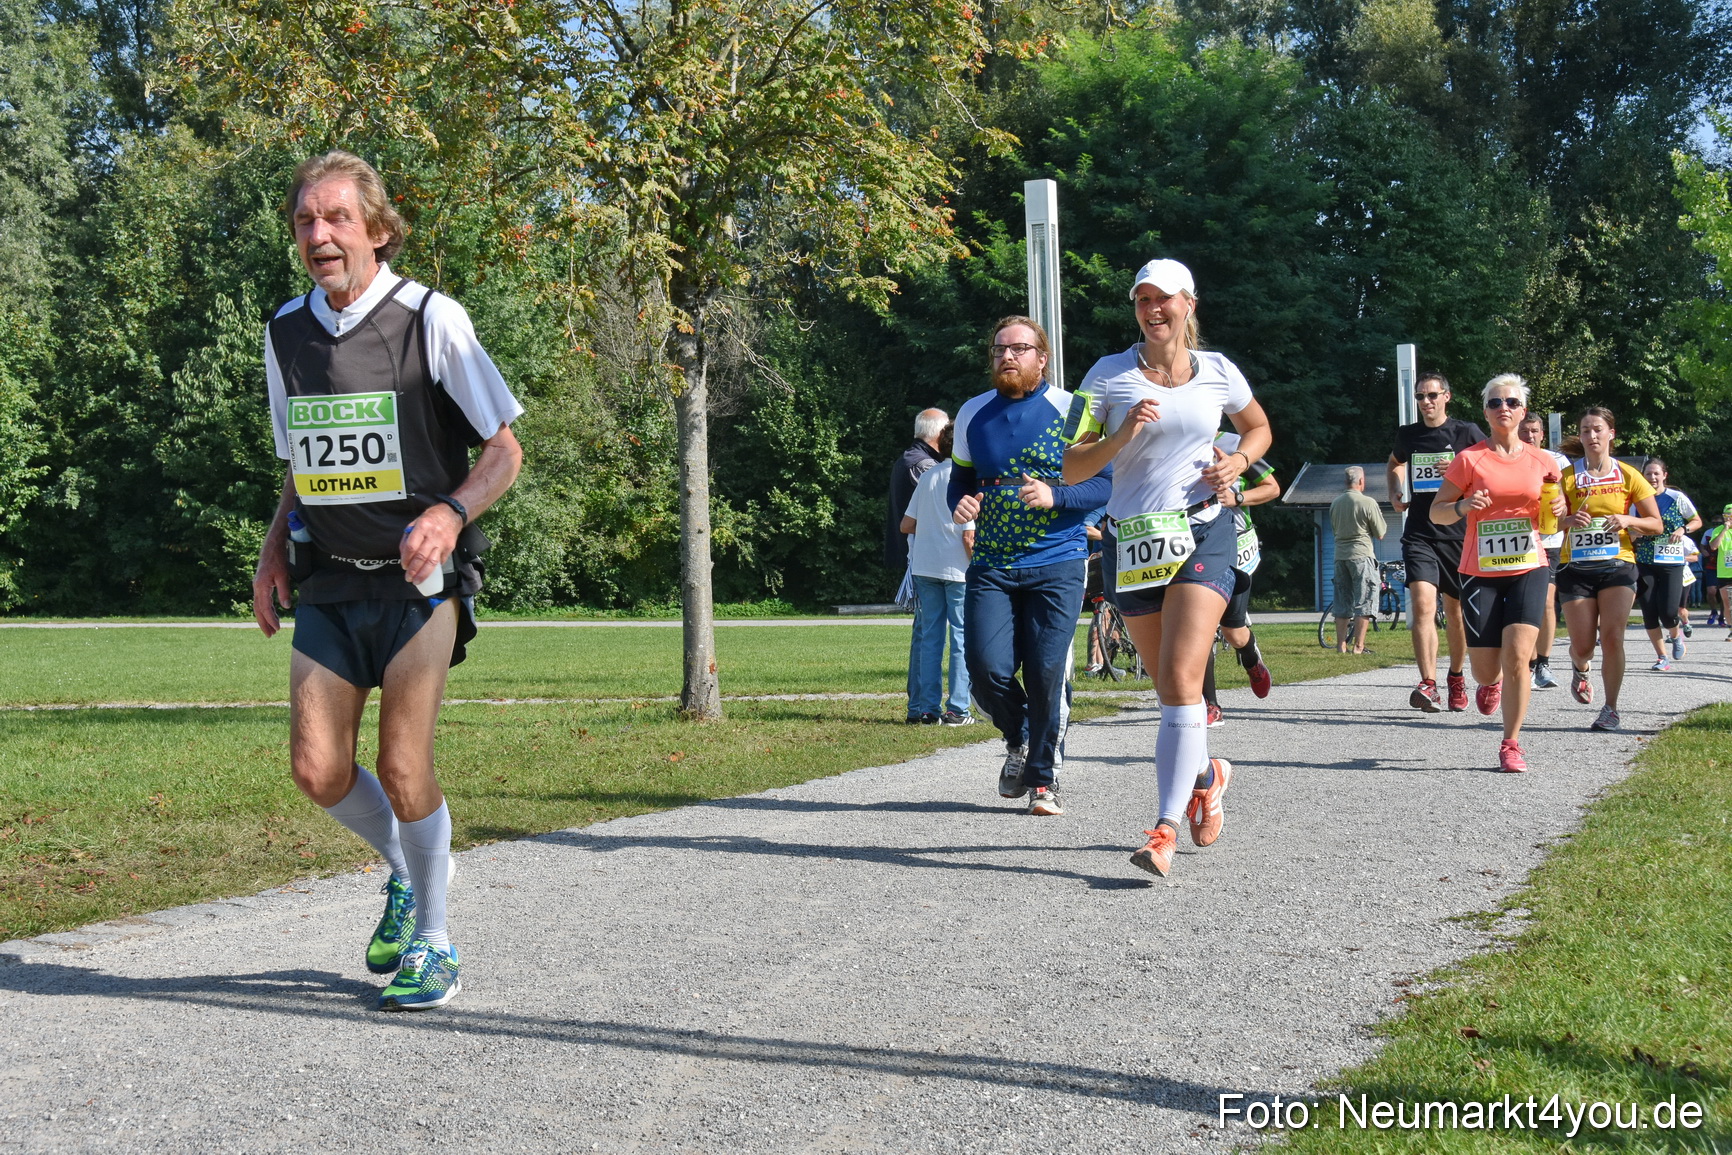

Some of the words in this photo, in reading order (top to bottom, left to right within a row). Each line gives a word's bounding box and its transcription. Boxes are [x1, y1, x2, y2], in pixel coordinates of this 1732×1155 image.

[292, 397, 386, 425] BOCK
[299, 432, 386, 468] 1250
[309, 476, 378, 493] LOTHAR
[1576, 489, 1597, 499] MAX
[1121, 515, 1183, 539] BOCK
[1482, 520, 1529, 535] BOCK
[1485, 536, 1529, 553] 1117
[1575, 533, 1613, 546] 2385
[1126, 536, 1186, 566] 1076
[1582, 548, 1607, 556] TANJA
[1658, 546, 1680, 554] 2605
[1491, 557, 1526, 565] SIMONE
[1141, 567, 1172, 580] ALEX
